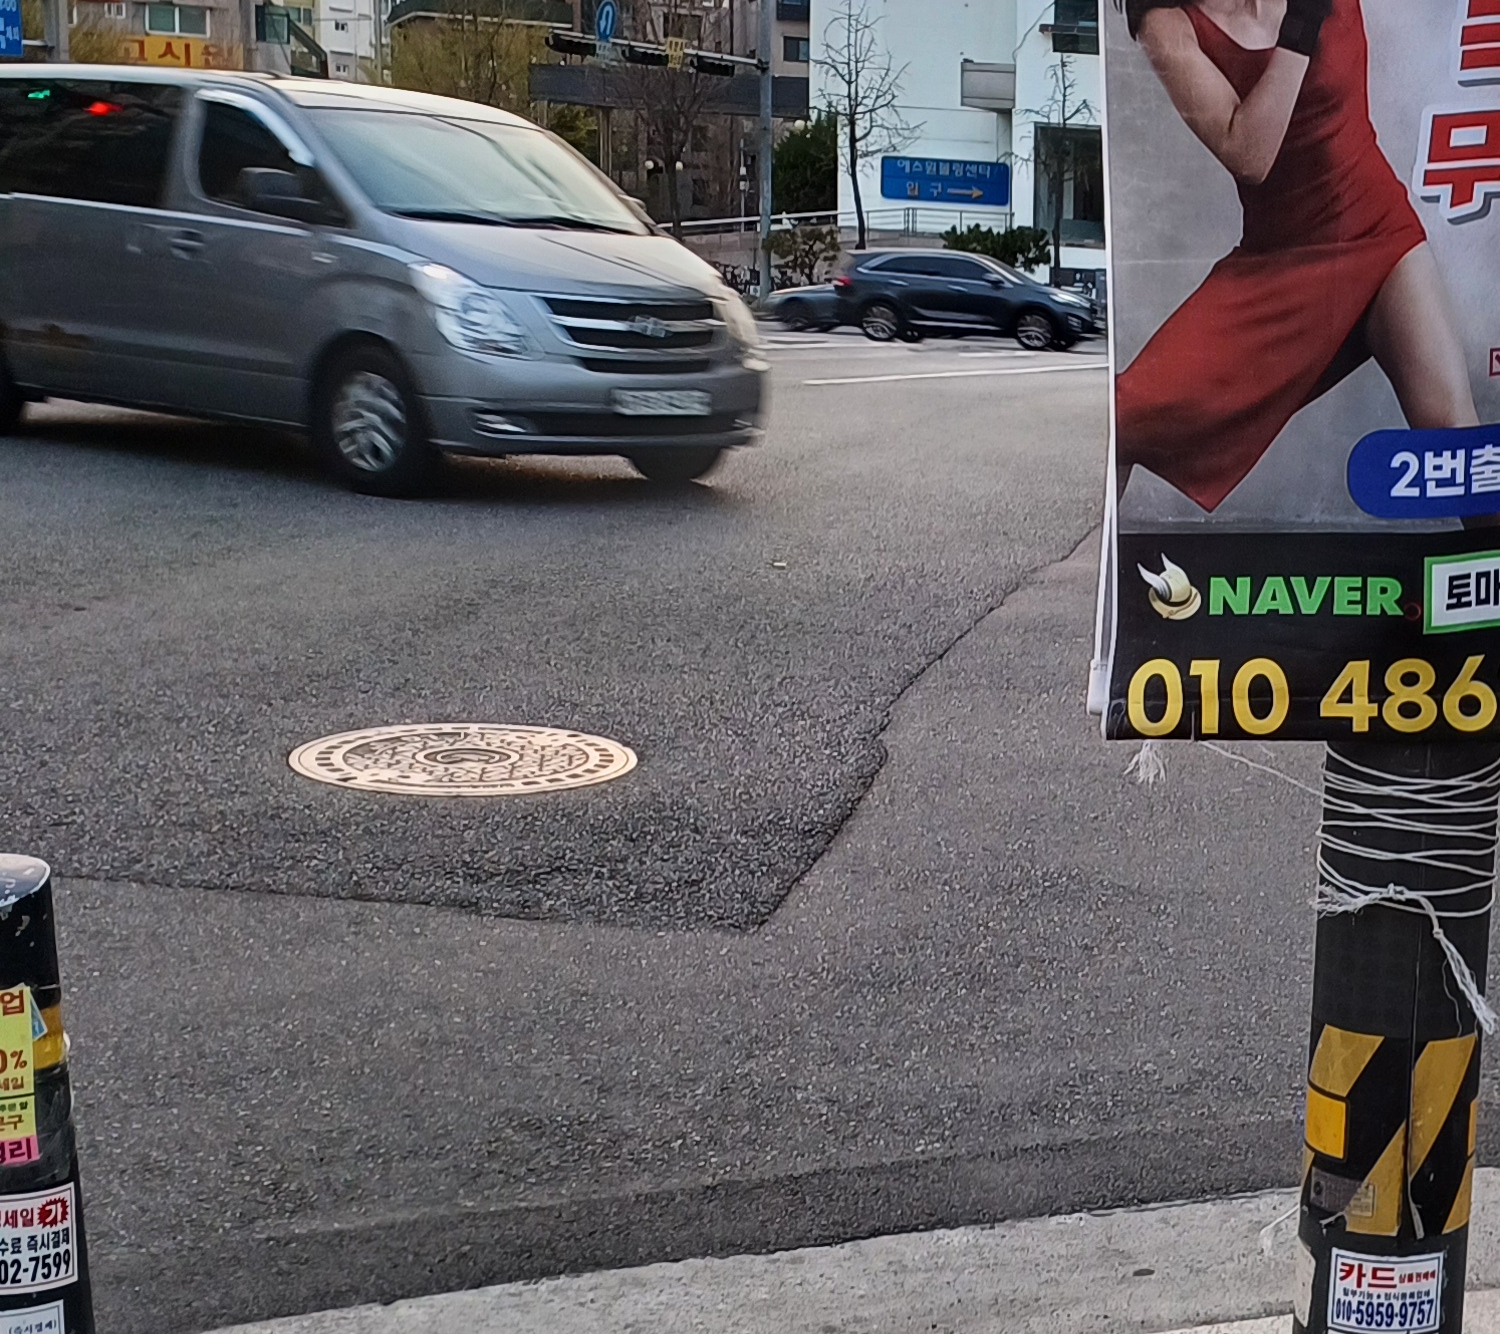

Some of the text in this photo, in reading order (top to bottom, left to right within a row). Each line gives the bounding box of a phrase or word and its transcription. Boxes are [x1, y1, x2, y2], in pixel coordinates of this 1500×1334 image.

[1208, 574, 1404, 617] NAVER
[1126, 657, 1290, 737] 010
[1338, 1261, 1397, 1289] 카드
